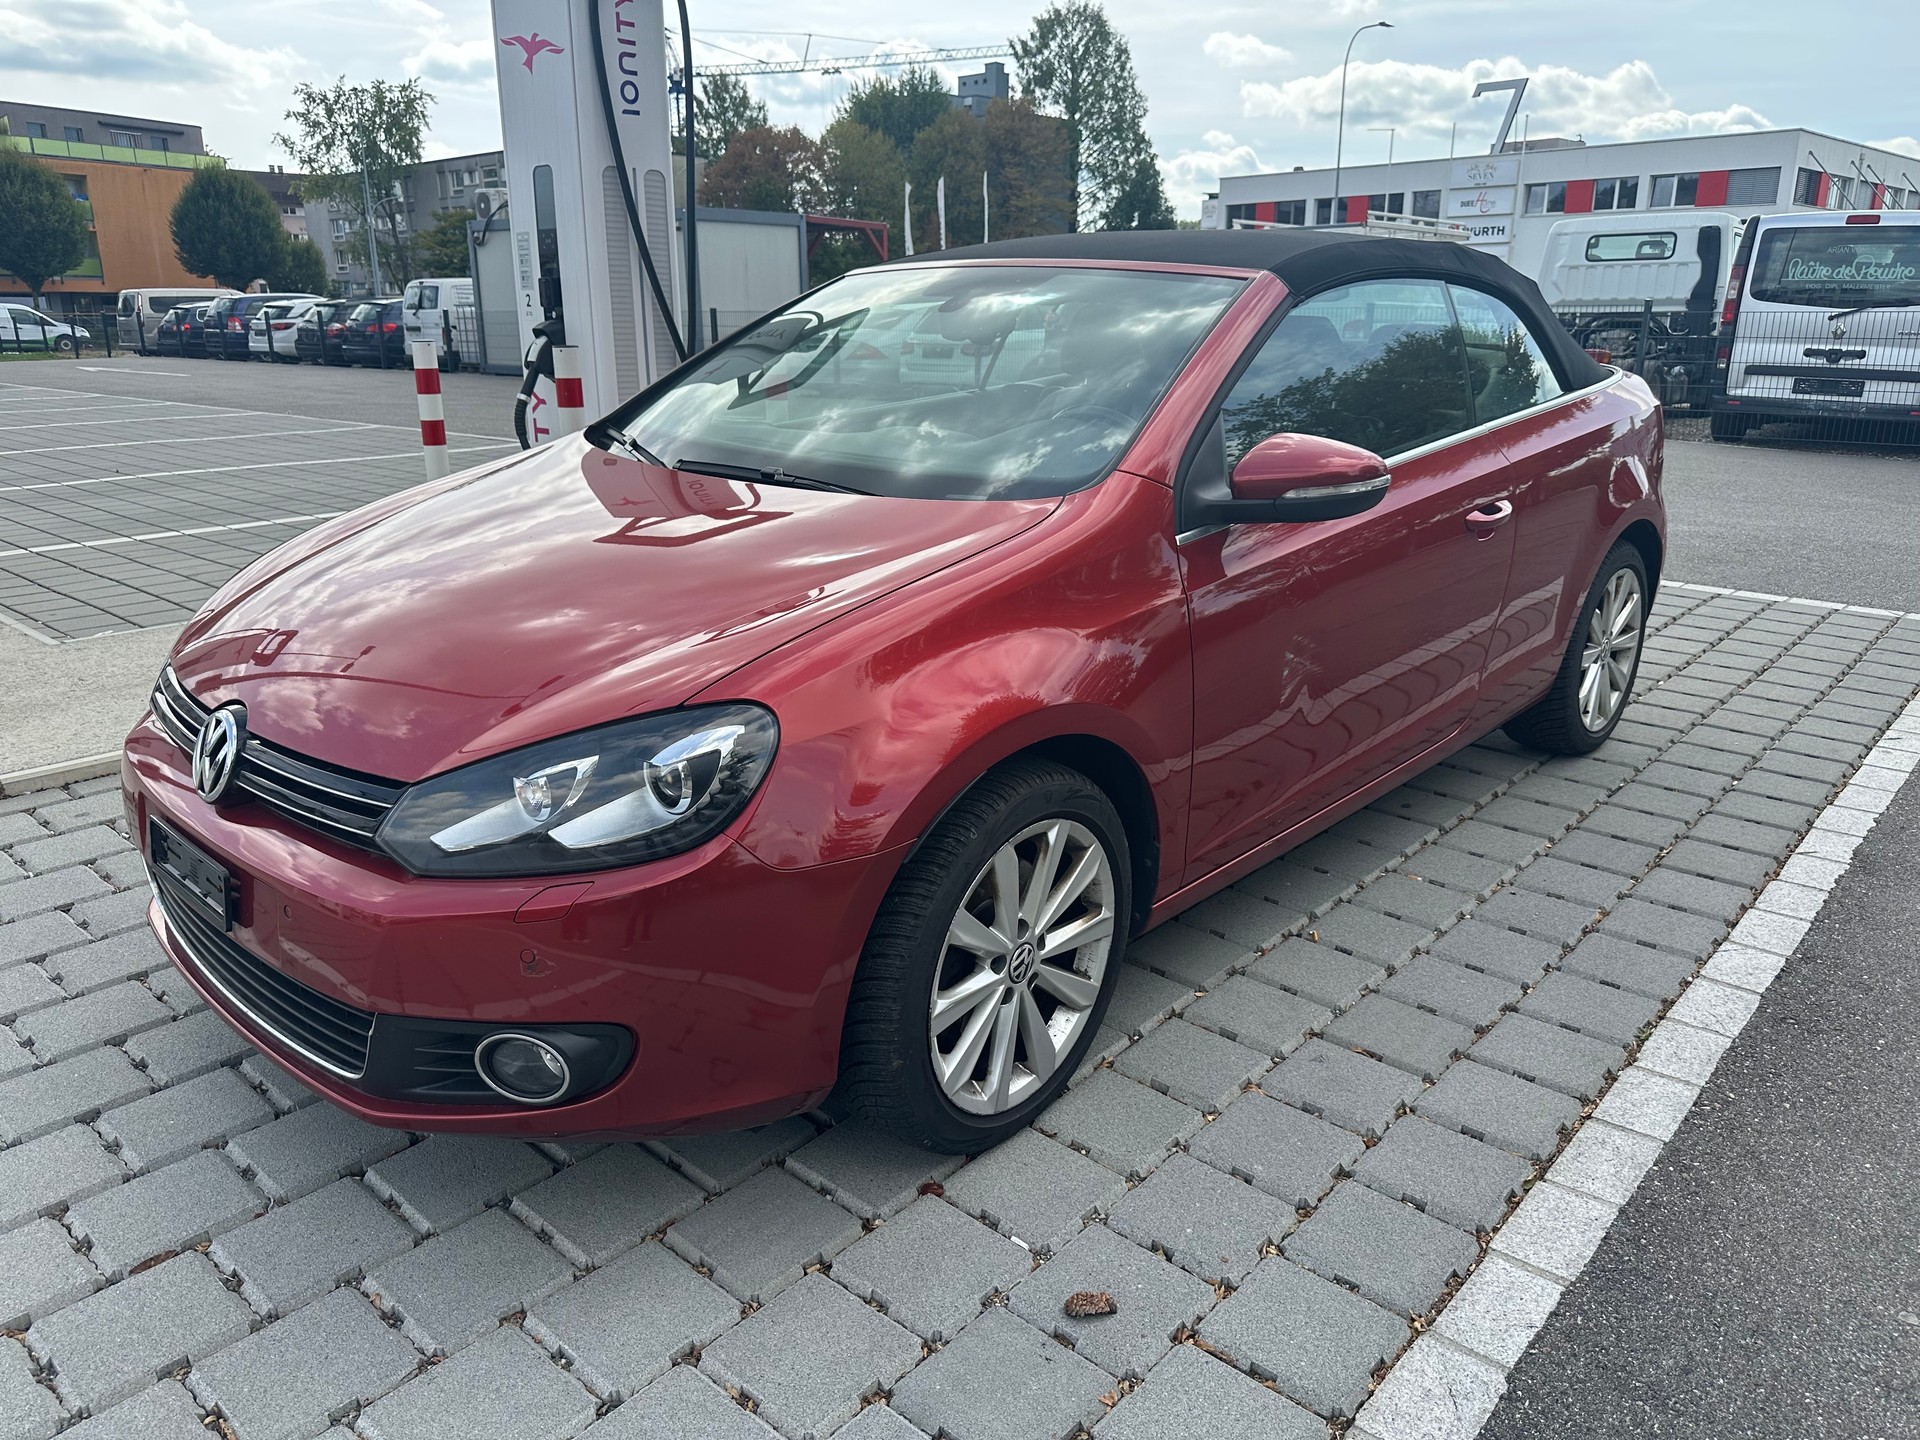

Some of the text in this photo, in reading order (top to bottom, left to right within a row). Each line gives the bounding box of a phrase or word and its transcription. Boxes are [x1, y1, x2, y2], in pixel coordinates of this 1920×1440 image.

[1472, 78, 1529, 155] 7
[1467, 172, 1494, 181] SEVEN
[1827, 246, 1850, 254] ARIAN
[1833, 264, 1854, 280] de
[525, 293, 532, 308] 2
